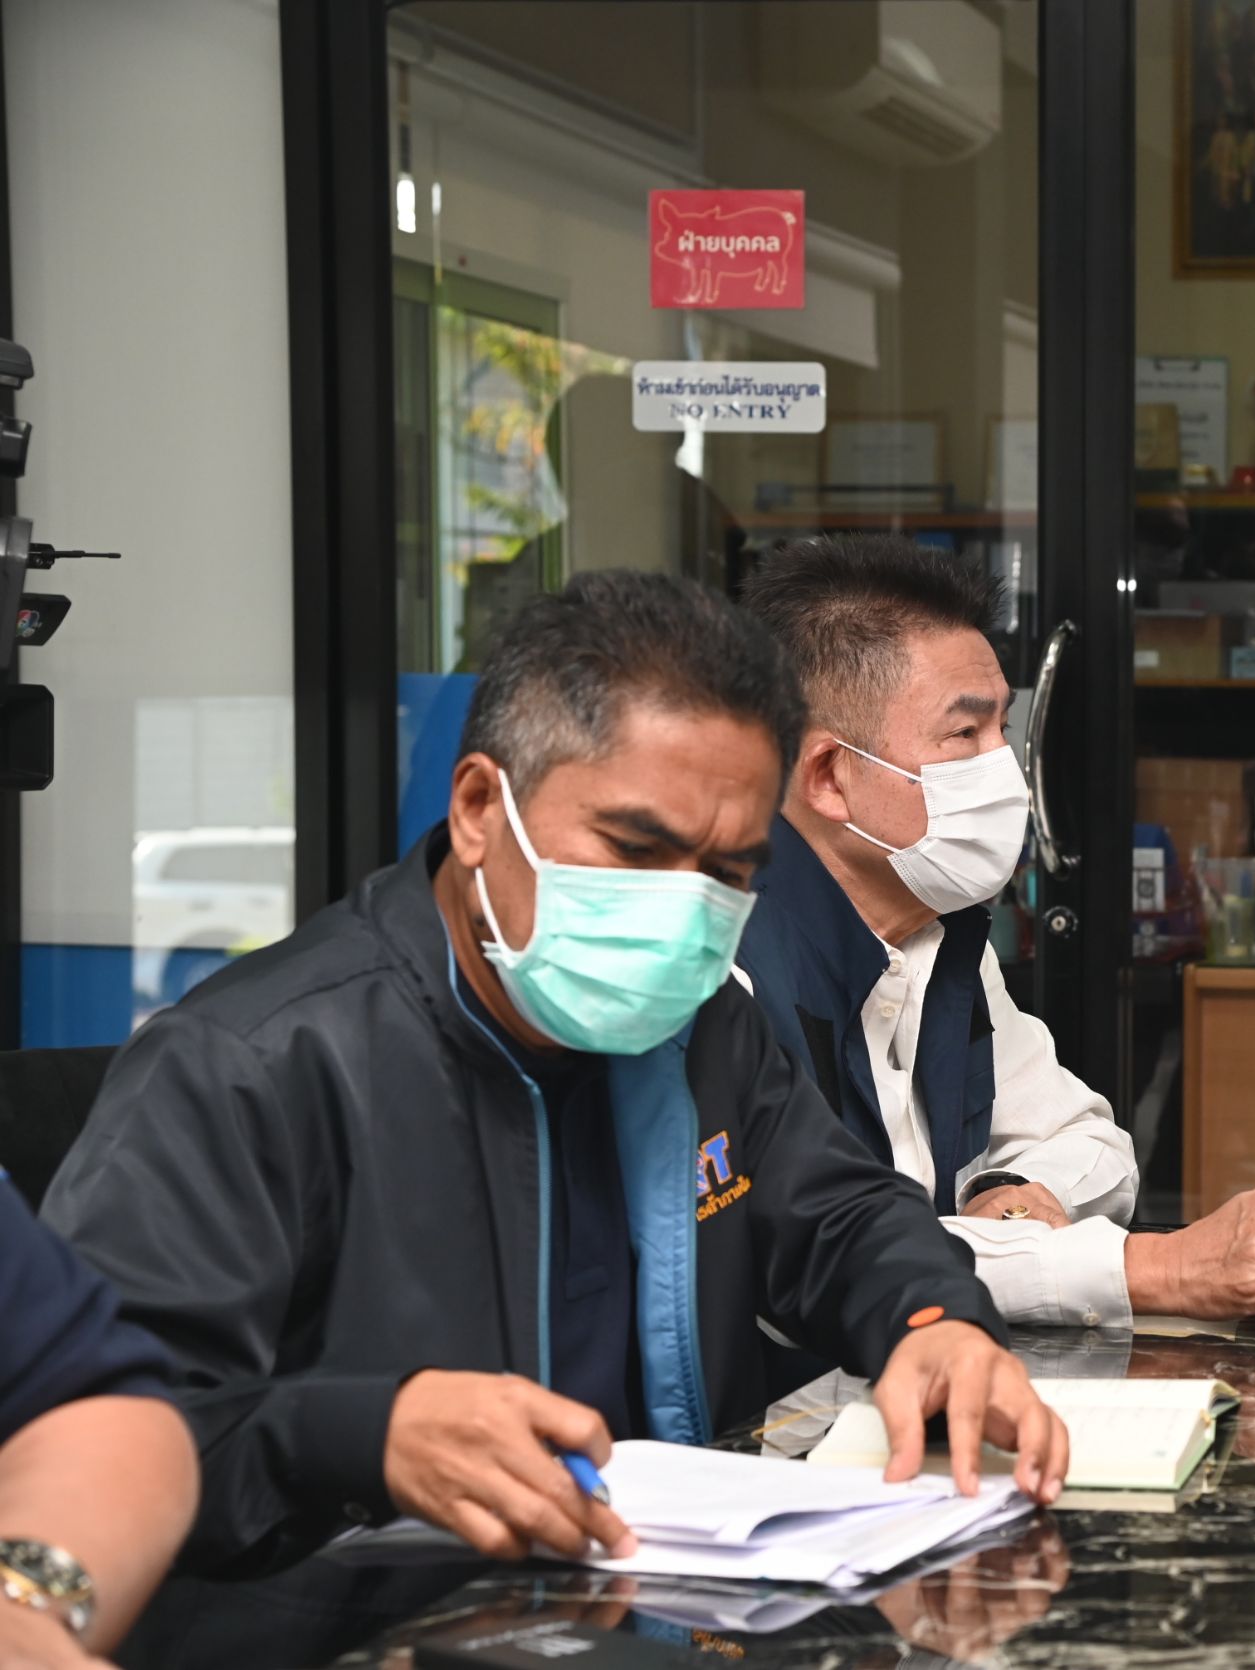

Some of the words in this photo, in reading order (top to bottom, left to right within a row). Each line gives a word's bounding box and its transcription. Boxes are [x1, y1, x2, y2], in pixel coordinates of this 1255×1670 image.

[678, 229, 781, 259] ฝ่ายบุคคล
[670, 402, 704, 420] NO
[713, 403, 792, 420] ENTRY
